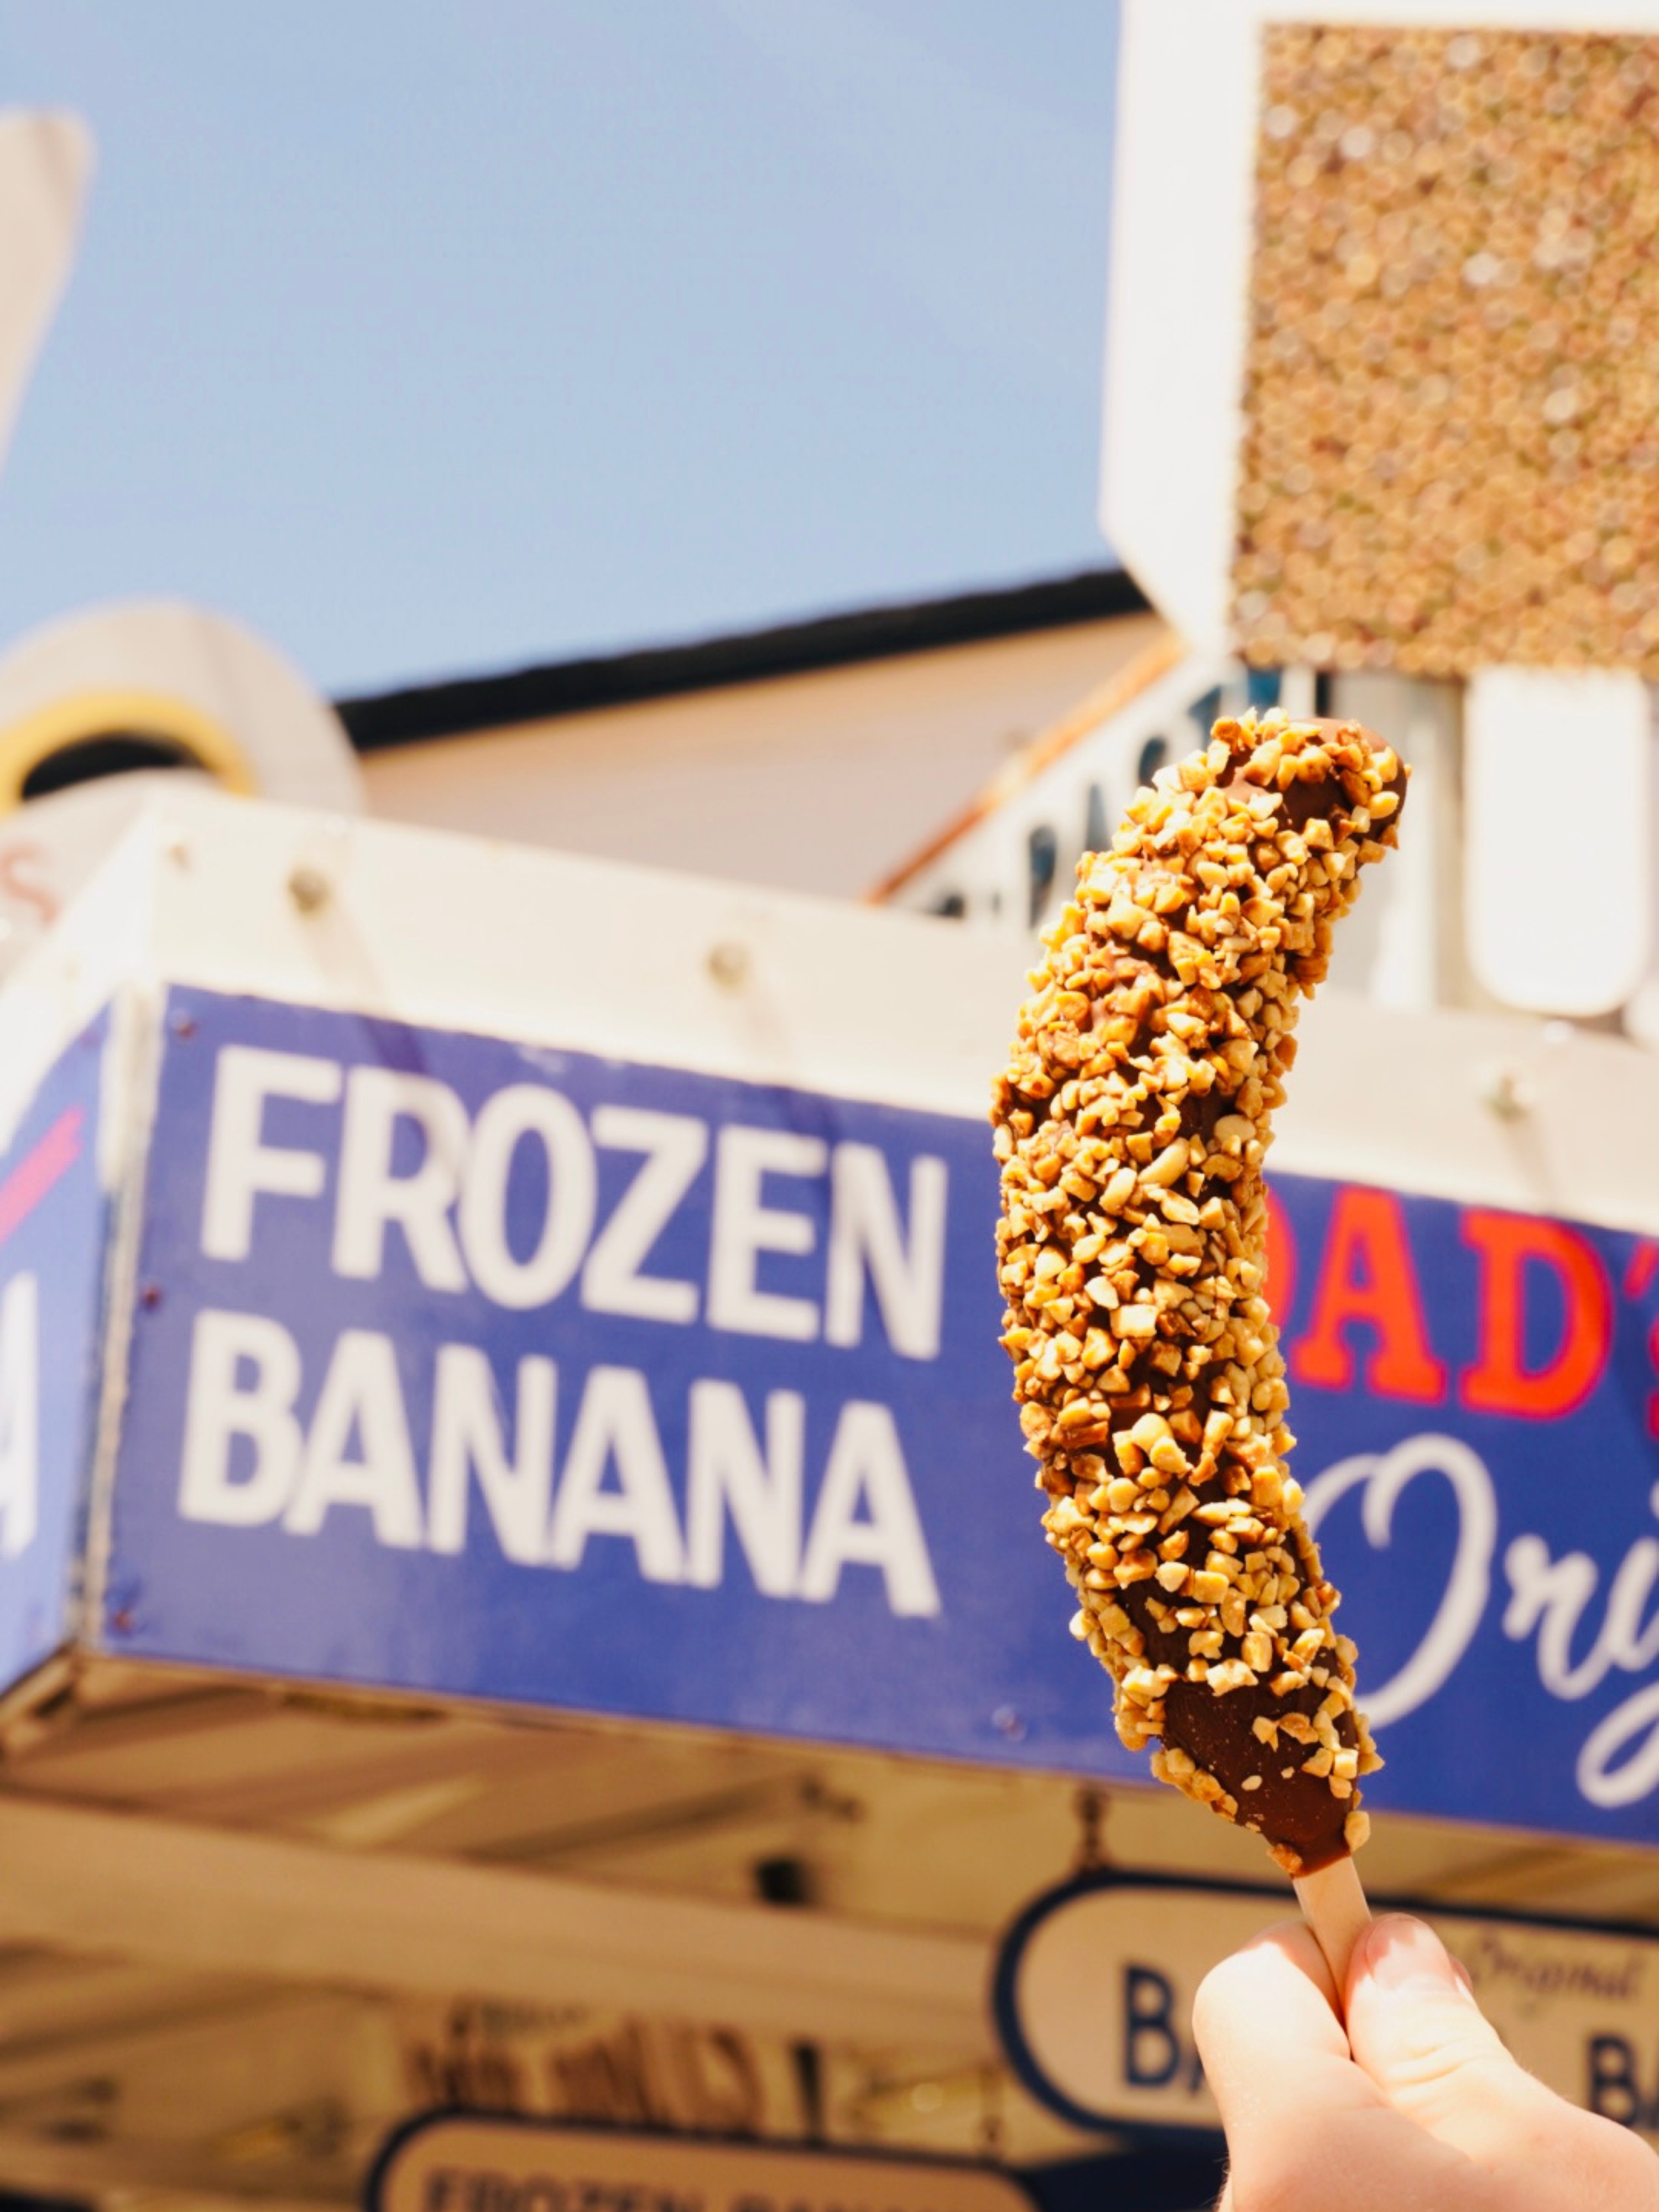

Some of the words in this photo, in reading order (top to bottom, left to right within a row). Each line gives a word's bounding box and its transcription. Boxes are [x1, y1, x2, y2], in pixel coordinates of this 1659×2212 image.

[200, 1044, 948, 1361] FROZEN
[1263, 1177, 1659, 1439] AD'
[177, 1308, 941, 1619] BANANA
